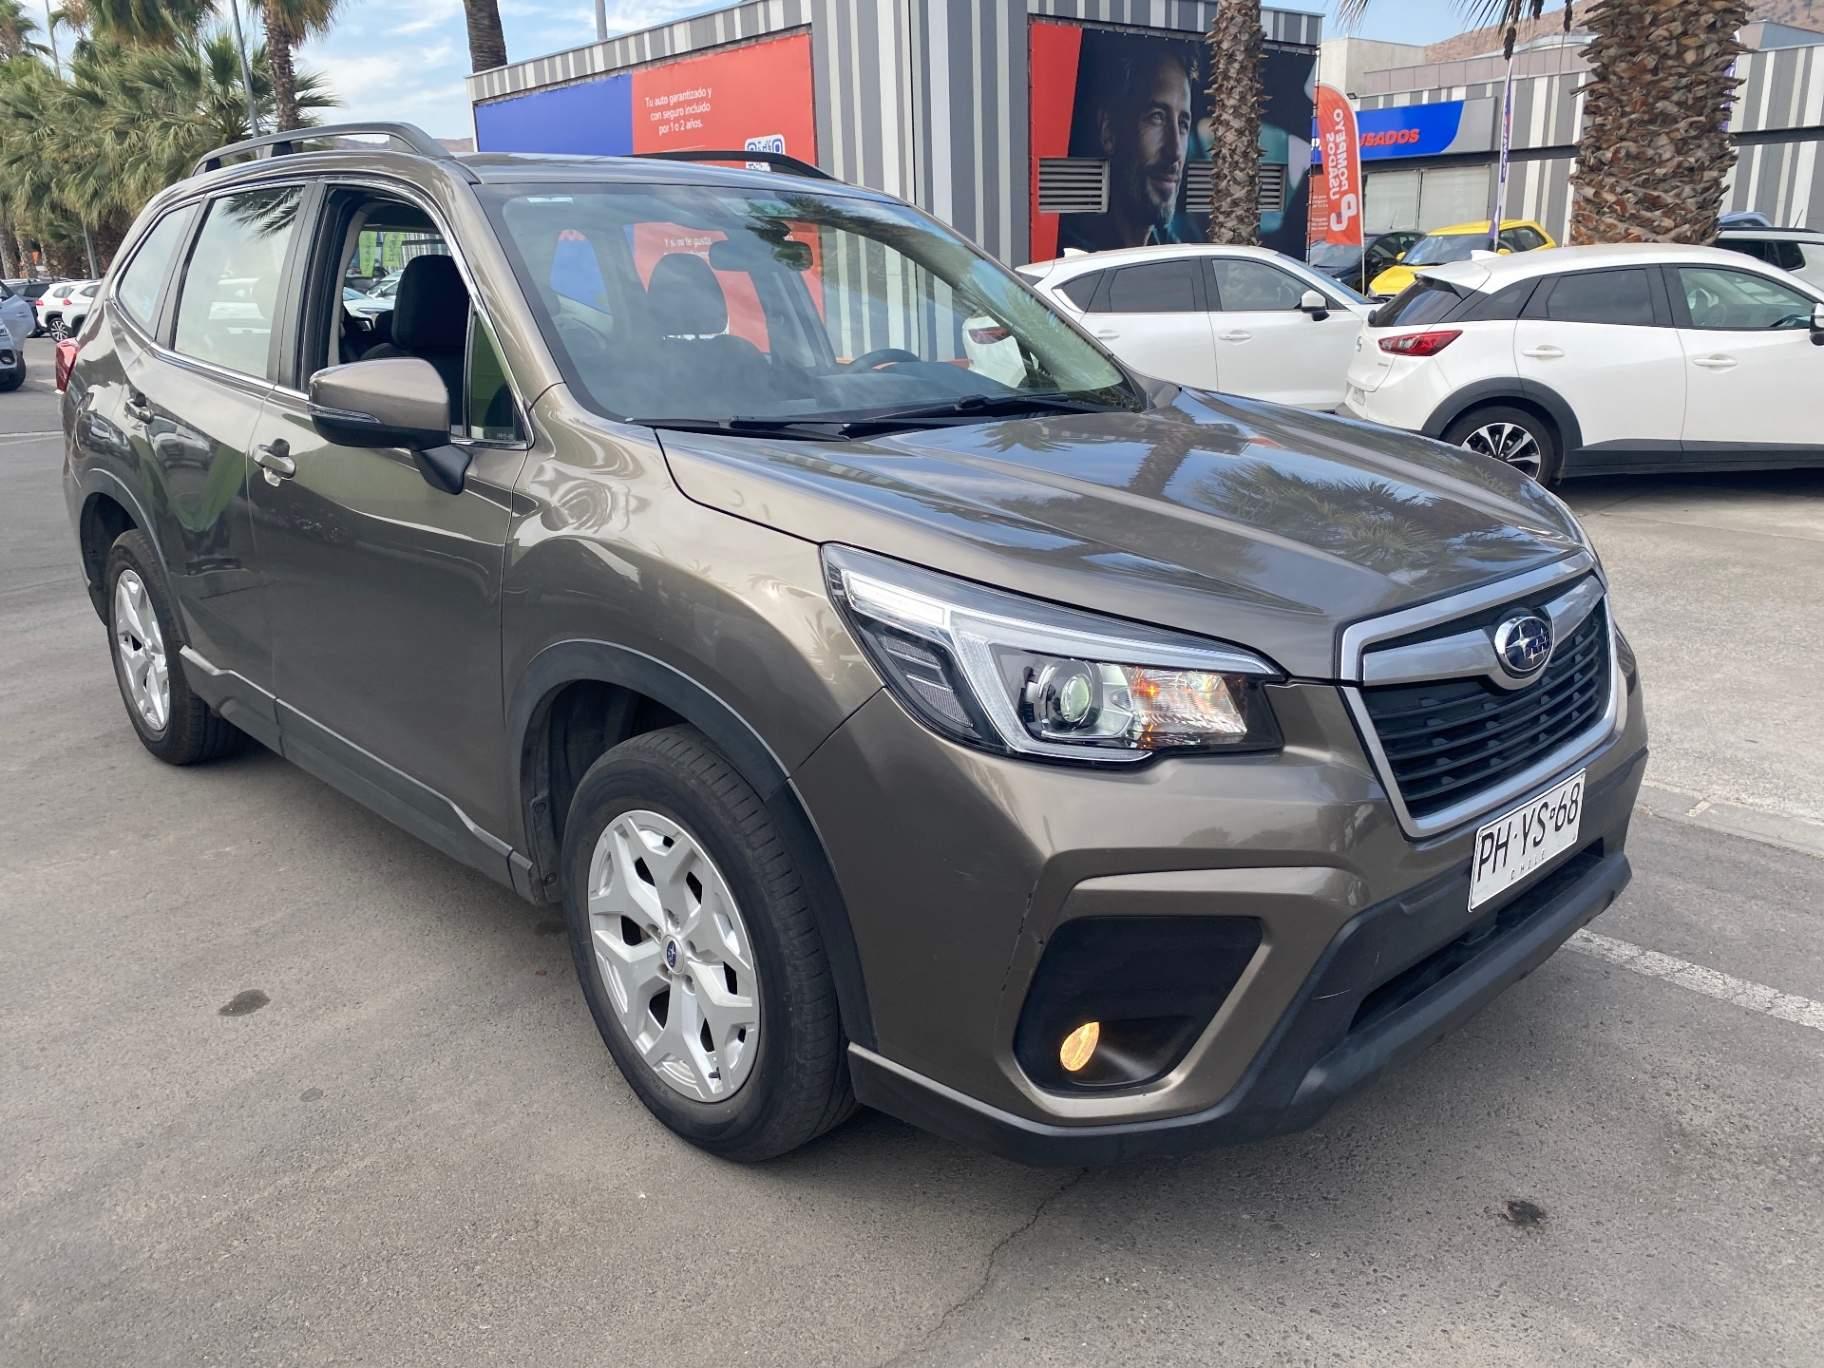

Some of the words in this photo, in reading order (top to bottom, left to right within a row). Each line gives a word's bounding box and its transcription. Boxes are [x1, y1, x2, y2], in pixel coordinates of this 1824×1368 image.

[655, 96, 668, 106] auto
[669, 88, 706, 105] garantizado
[650, 112, 662, 121] con
[663, 108, 684, 120] seguro
[685, 102, 711, 115] incluido
[658, 125, 669, 136] por
[680, 120, 685, 130] 2
